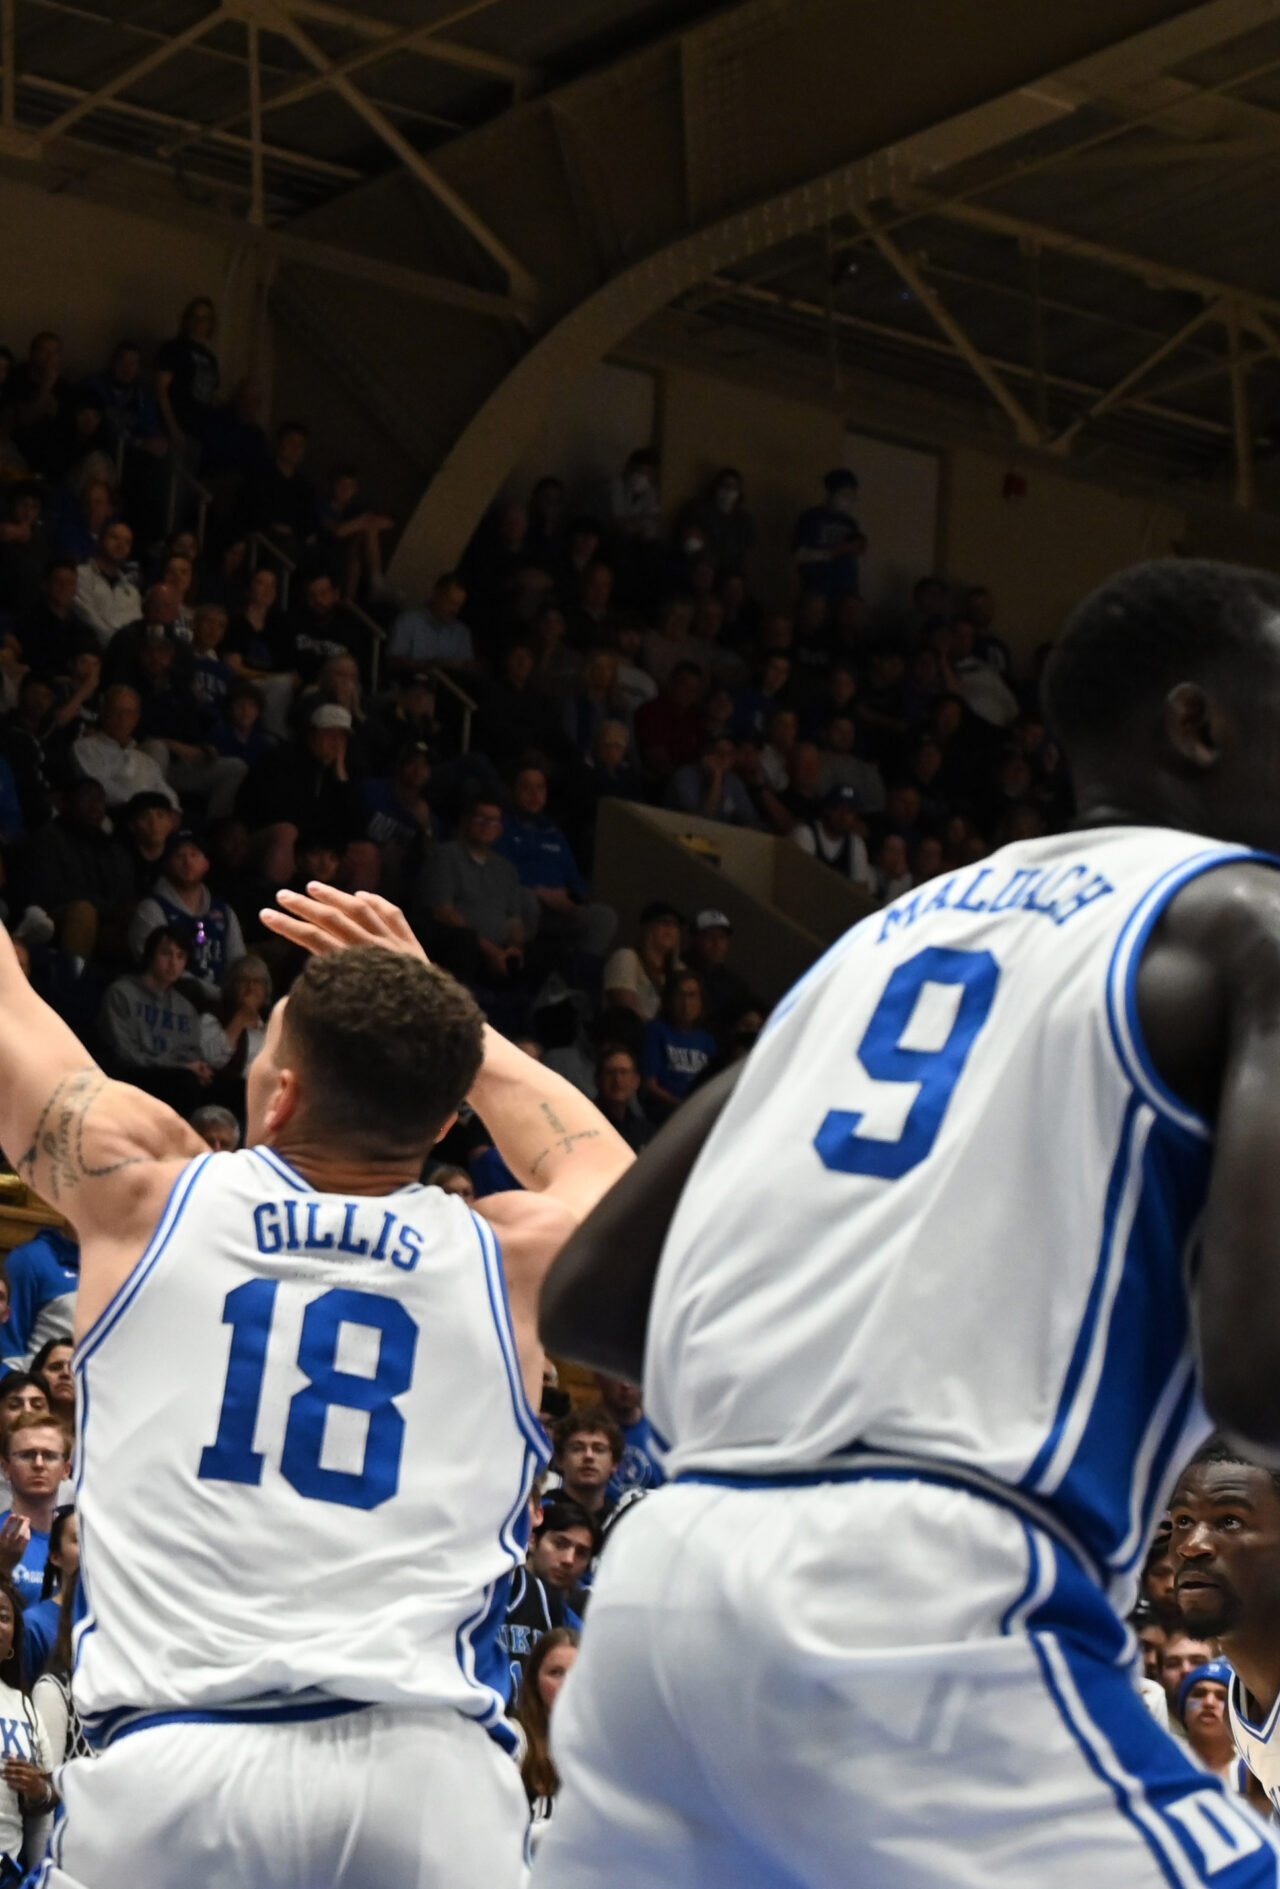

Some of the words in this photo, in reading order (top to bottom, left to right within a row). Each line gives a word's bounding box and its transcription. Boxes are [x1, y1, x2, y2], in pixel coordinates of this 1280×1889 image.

[813, 945, 1002, 1181] 9
[253, 1200, 423, 1271] GILLIS
[197, 1278, 419, 1511] 18
[1164, 1789, 1263, 1877] D
